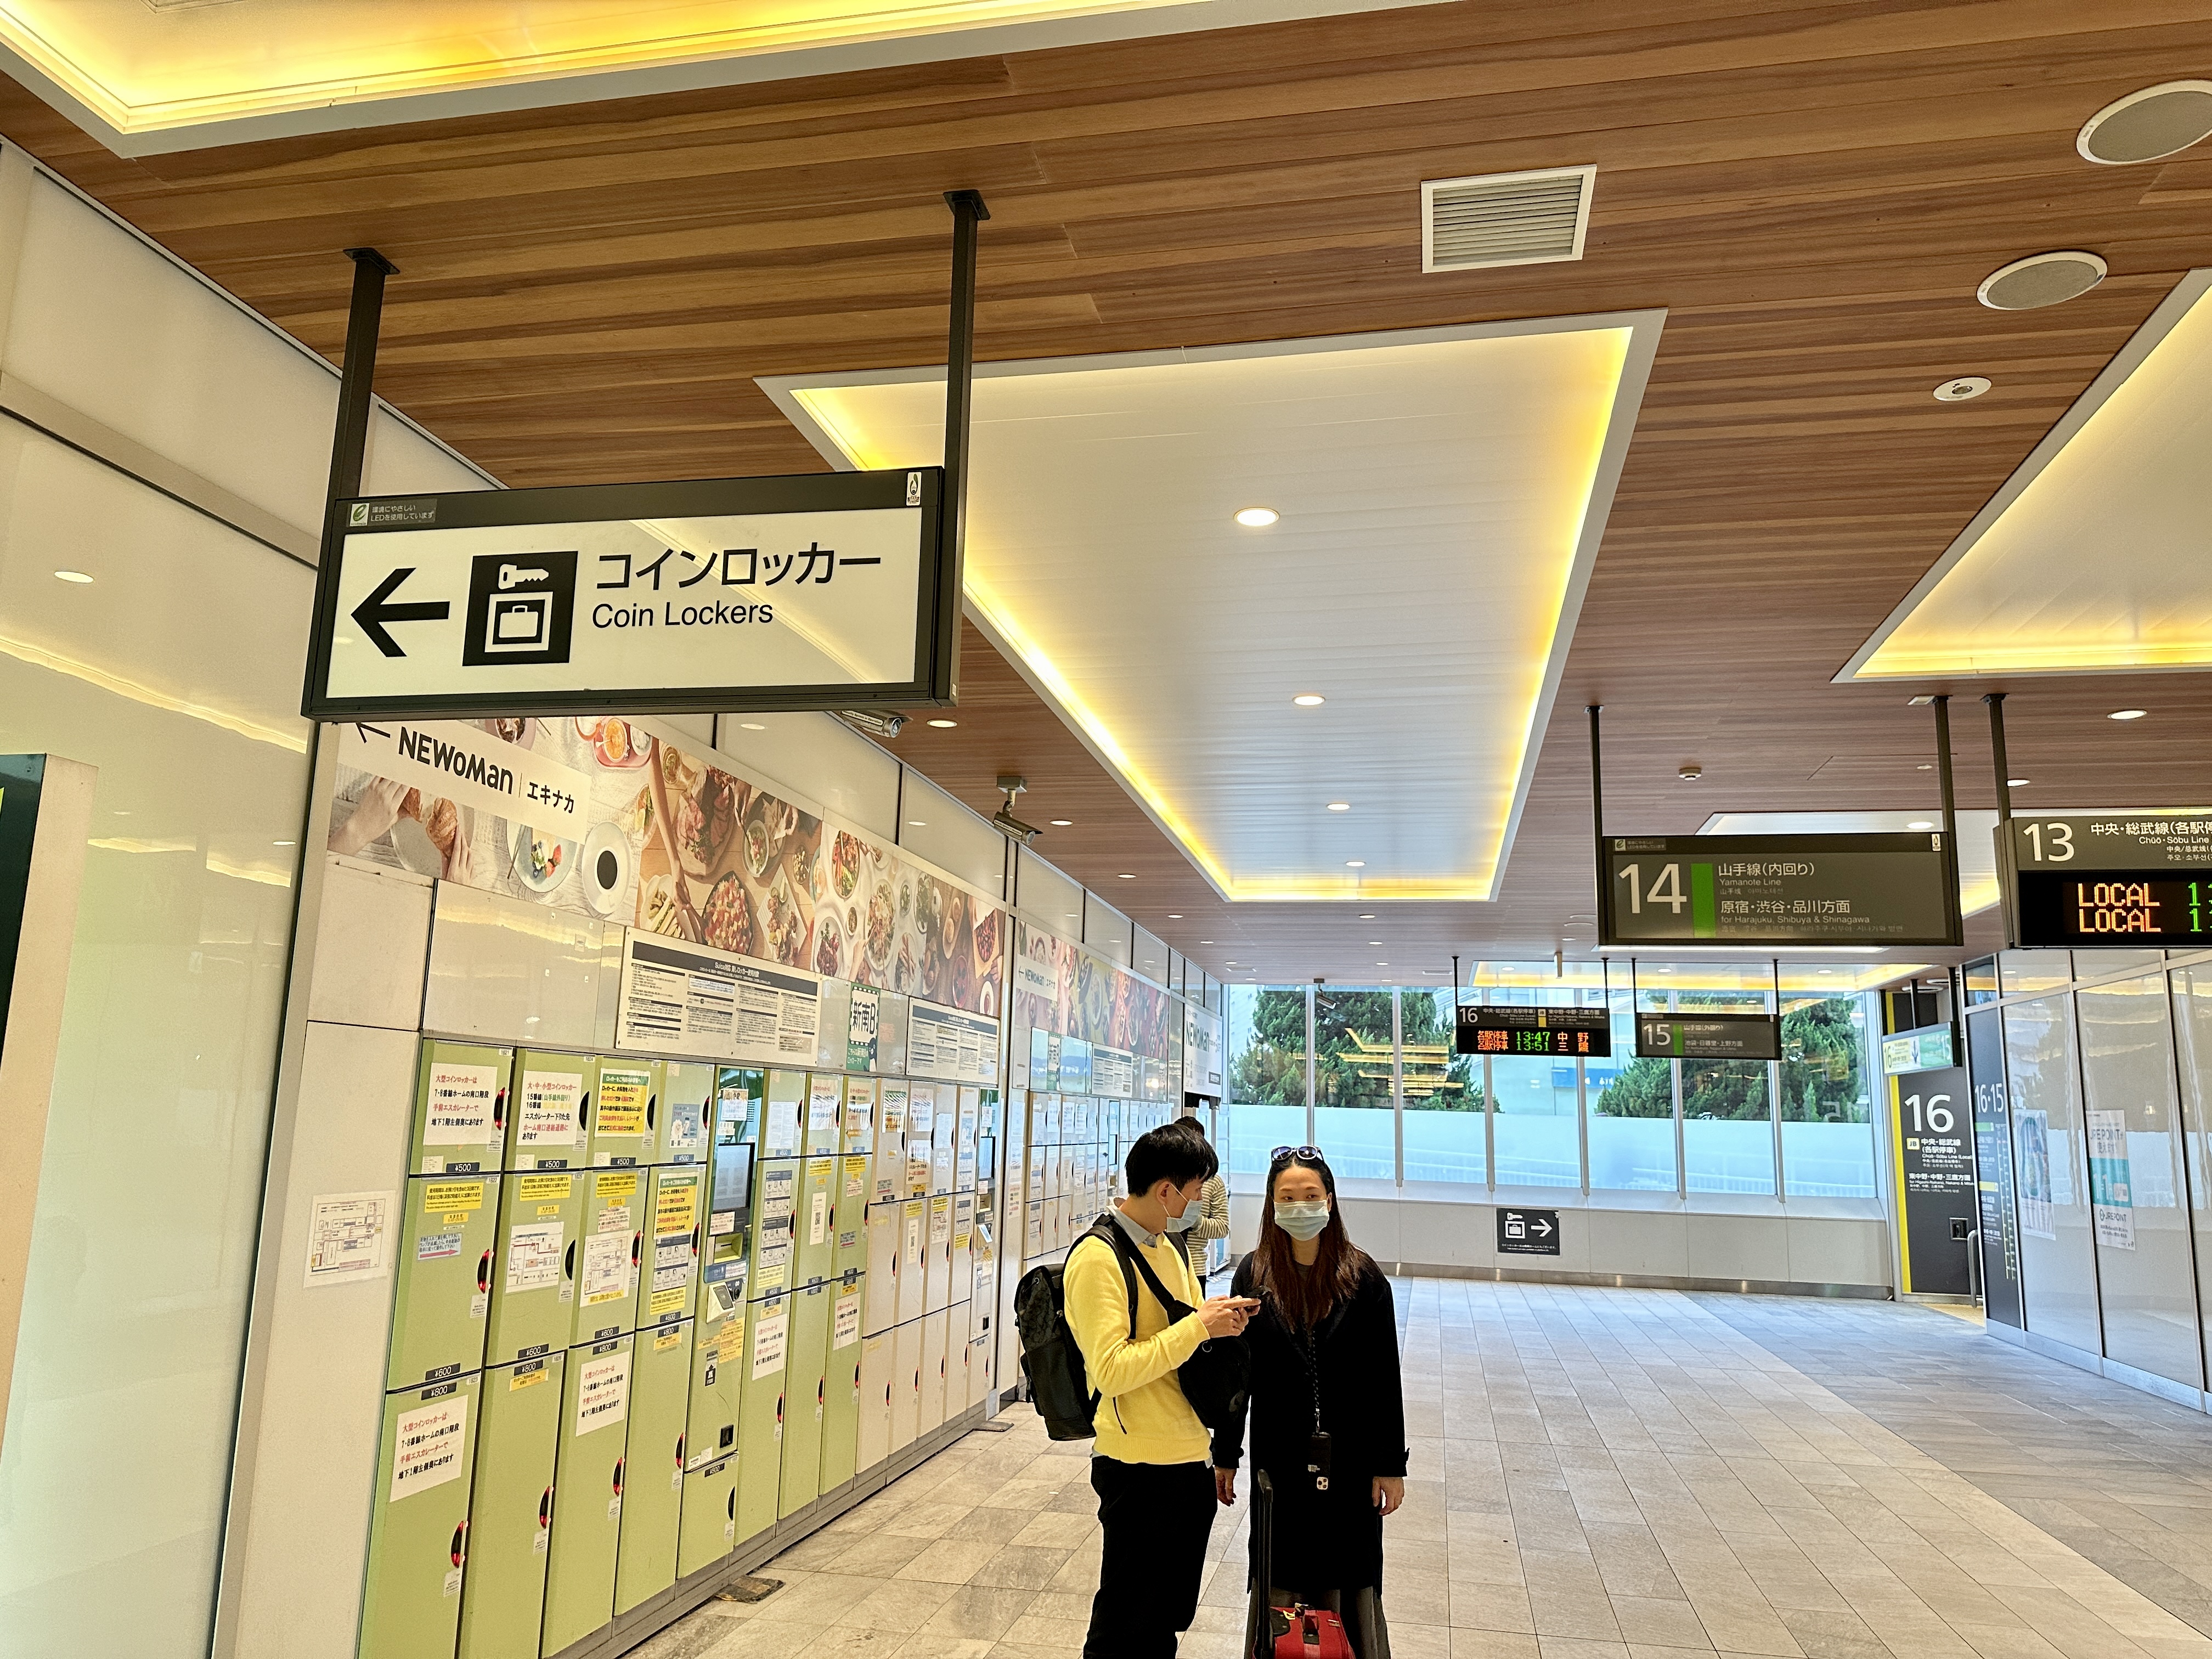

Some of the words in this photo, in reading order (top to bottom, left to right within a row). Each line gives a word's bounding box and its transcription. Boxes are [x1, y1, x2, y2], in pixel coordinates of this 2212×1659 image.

[370, 511, 435, 521] LEDを使用しています
[597, 542, 881, 590] コインロッカー
[592, 603, 653, 628] Coin
[665, 600, 774, 626] Lockers
[399, 726, 513, 795] NEWoMan
[527, 781, 574, 814] エキナカ
[2023, 822, 2075, 862] 13
[1718, 862, 1815, 877] 山手線(内回り)
[1618, 863, 1687, 915] 14
[2078, 883, 2160, 907] LOCAL
[1720, 900, 1850, 913] 原宿・渋谷・品川方面
[1777, 916, 1812, 924] Shibuya
[1822, 915, 1870, 924] Shinagawa
[2079, 908, 2162, 933] LOCAL
[1459, 1007, 1479, 1023] 16
[1477, 1030, 1509, 1041] 各駅停車
[1516, 1031, 1550, 1041] 13:47
[1643, 1023, 1671, 1046] 15
[1477, 1041, 1509, 1051] 各駅停車
[1516, 1041, 1550, 1051] 13:51
[435, 1075, 477, 1084] 大型コインロッカーは
[527, 1081, 577, 1091] 大・中・小型コインロッカー
[433, 1103, 479, 1112] 手前エスカレーターで
[1904, 1094, 1954, 1133] 16
[431, 1118, 484, 1126] 地下1階左側奥にあります
[524, 1113, 570, 1121] エスカレーター下りた先
[522, 1132, 538, 1141] あります
[455, 1163, 471, 1172] ¥500
[601, 1328, 613, 1336] ¥600
[526, 1346, 541, 1356] ¥600
[599, 1344, 611, 1352] ¥800
[435, 1366, 452, 1378] ¥600
[522, 1363, 536, 1373] ¥800
[431, 1385, 448, 1397] ¥800
[402, 1411, 448, 1434] 大型コインロッカーは
[400, 1442, 449, 1465] 手前エスカレーターで
